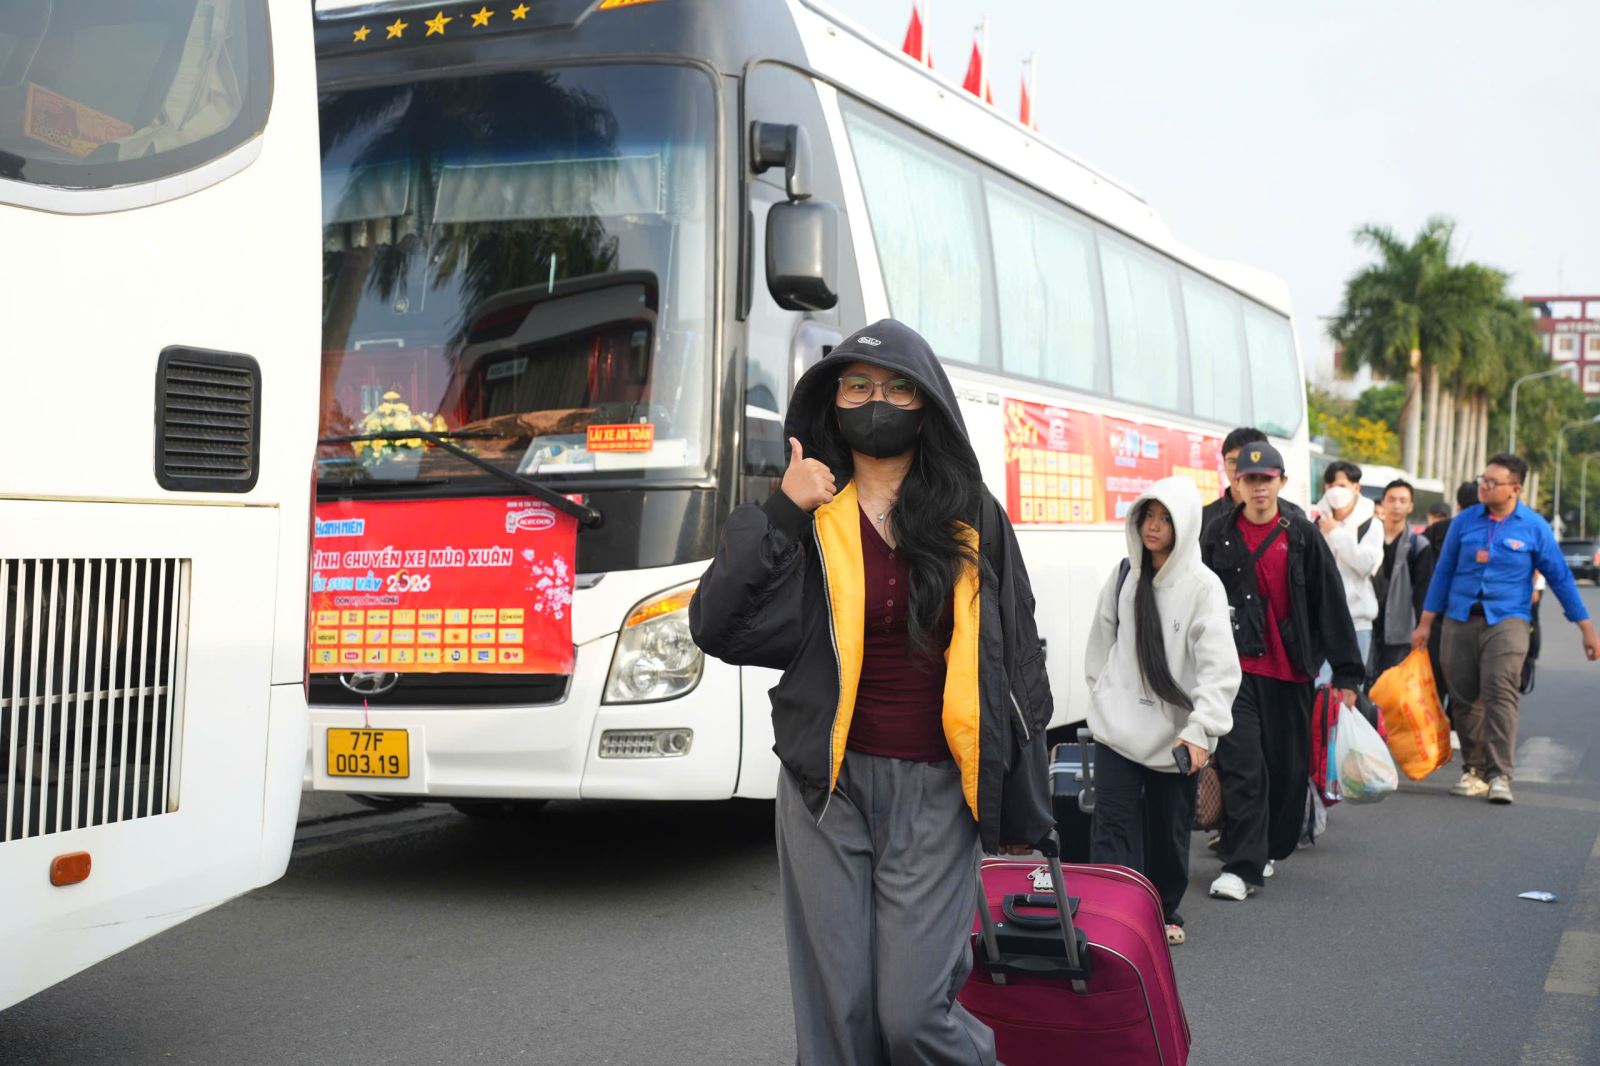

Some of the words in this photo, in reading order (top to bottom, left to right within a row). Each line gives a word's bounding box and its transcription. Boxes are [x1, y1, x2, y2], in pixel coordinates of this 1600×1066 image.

[589, 428, 602, 441] LÁI
[603, 428, 615, 441] XE
[616, 428, 628, 441] AN
[629, 426, 652, 441] TOÀN
[315, 519, 341, 538] HANH
[314, 549, 340, 569] ÌNH
[343, 545, 402, 568] CHUYẾN
[404, 550, 426, 568] XE
[428, 546, 465, 568] MÙA
[467, 545, 513, 567] XUÂN
[312, 571, 327, 592] ẾT
[327, 577, 354, 592] SUM
[387, 570, 431, 592] 2026
[350, 732, 384, 751] 77F
[336, 753, 400, 774] 003.19
